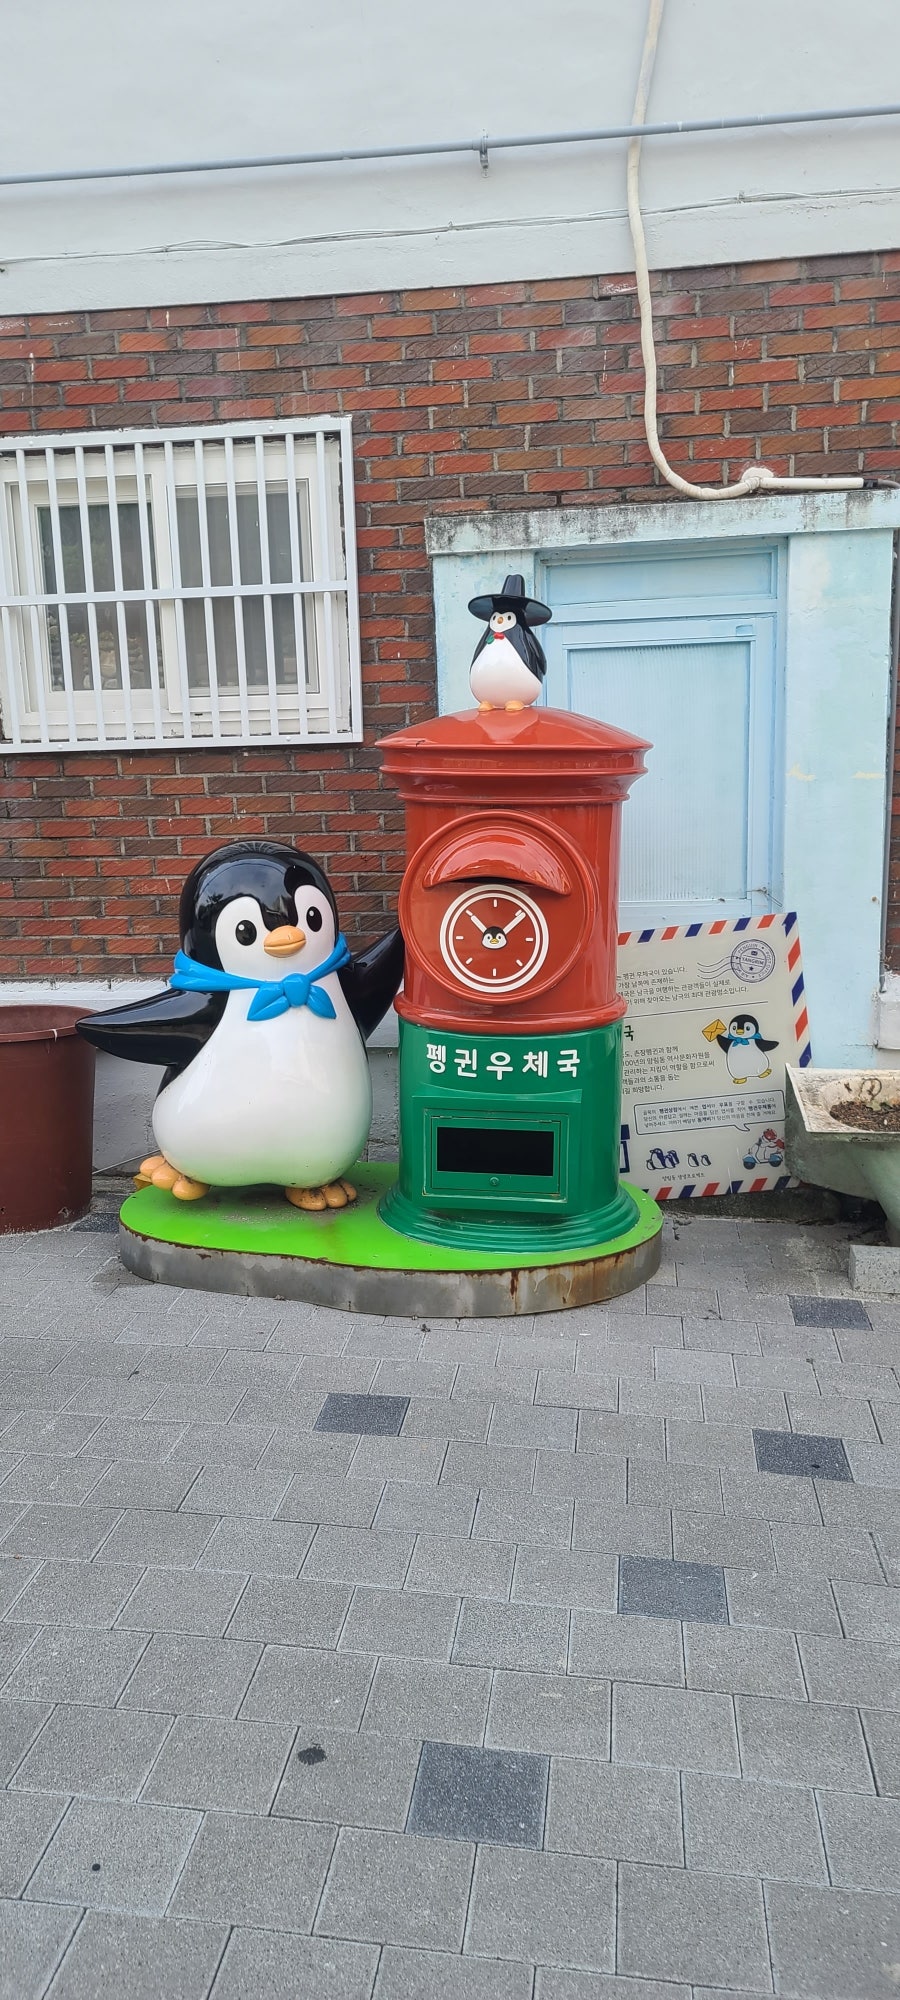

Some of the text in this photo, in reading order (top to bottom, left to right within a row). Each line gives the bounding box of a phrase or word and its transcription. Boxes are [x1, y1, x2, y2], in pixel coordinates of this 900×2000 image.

[622, 972, 635, 980] 펭귄
[637, 969, 660, 978] 우체국이
[651, 976, 675, 986] 존재하는
[637, 987, 655, 996] 남극을
[656, 984, 680, 994] 여행하는
[681, 980, 711, 991] 관광객들이
[713, 979, 731, 988] 실제로
[647, 995, 671, 1004] 찾아오는
[665, 1045, 679, 1054] 함께
[667, 1051, 710, 1062] 역사문화자원을
[426, 1043, 581, 1081] 펭귄우체국
[623, 1060, 715, 1076] 관리하는 지킴이 역할을 함으로써
[648, 1074, 666, 1083] 소통을
[667, 1073, 680, 1081] 돕는
[632, 1084, 664, 1094] 희망합니다.
